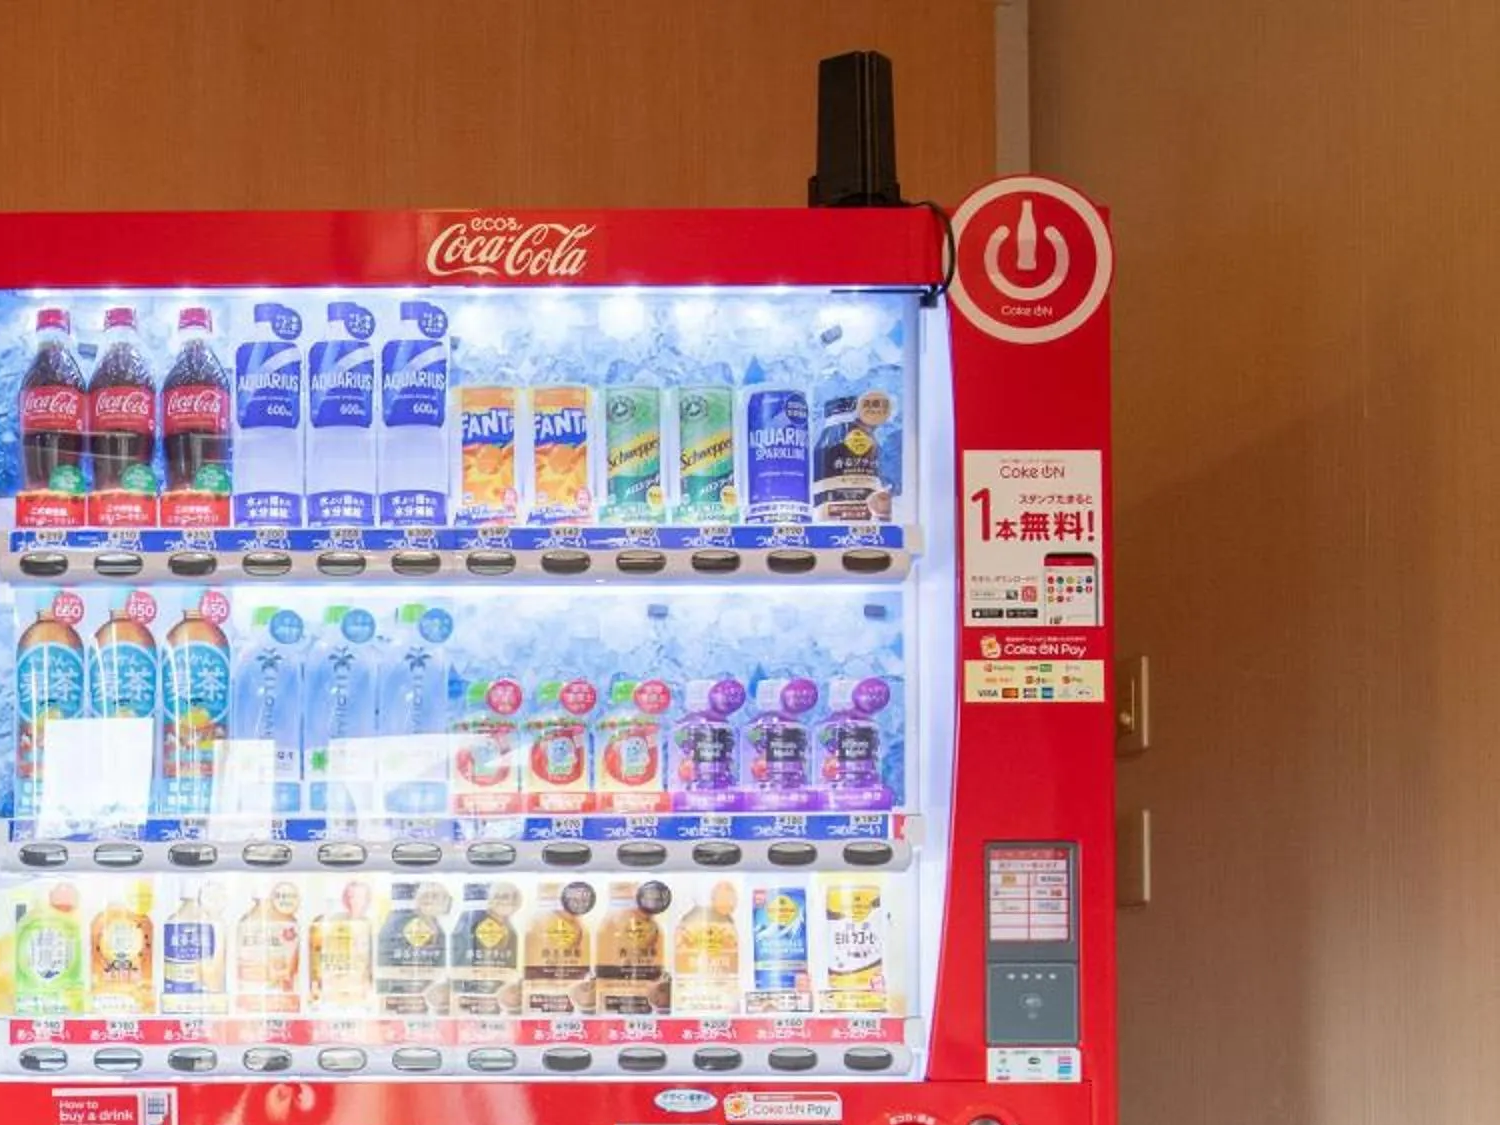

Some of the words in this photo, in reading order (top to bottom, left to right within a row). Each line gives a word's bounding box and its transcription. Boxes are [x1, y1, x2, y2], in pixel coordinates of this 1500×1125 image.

[238, 372, 299, 391] AQUARIUS
[311, 371, 373, 391] AQUARIUS
[383, 371, 446, 390] AQUARIUS
[461, 408, 515, 439] FANT
[533, 408, 587, 439] FANT
[607, 436, 661, 470] Schweppe
[680, 437, 734, 470] Schweppe
[1000, 465, 1038, 479] Coke
[1018, 494, 1093, 505] スタンプたまると
[128, 603, 154, 617] 650
[1004, 644, 1037, 656] Coke
[1060, 644, 1087, 658] Pay
[59, 1100, 85, 1109] How
[86, 1100, 99, 1109] to
[753, 1104, 784, 1115] Coke
[807, 1104, 831, 1117] Pay
[59, 1110, 85, 1123] buy
[88, 1112, 97, 1121] a
[100, 1110, 133, 1121] drink
